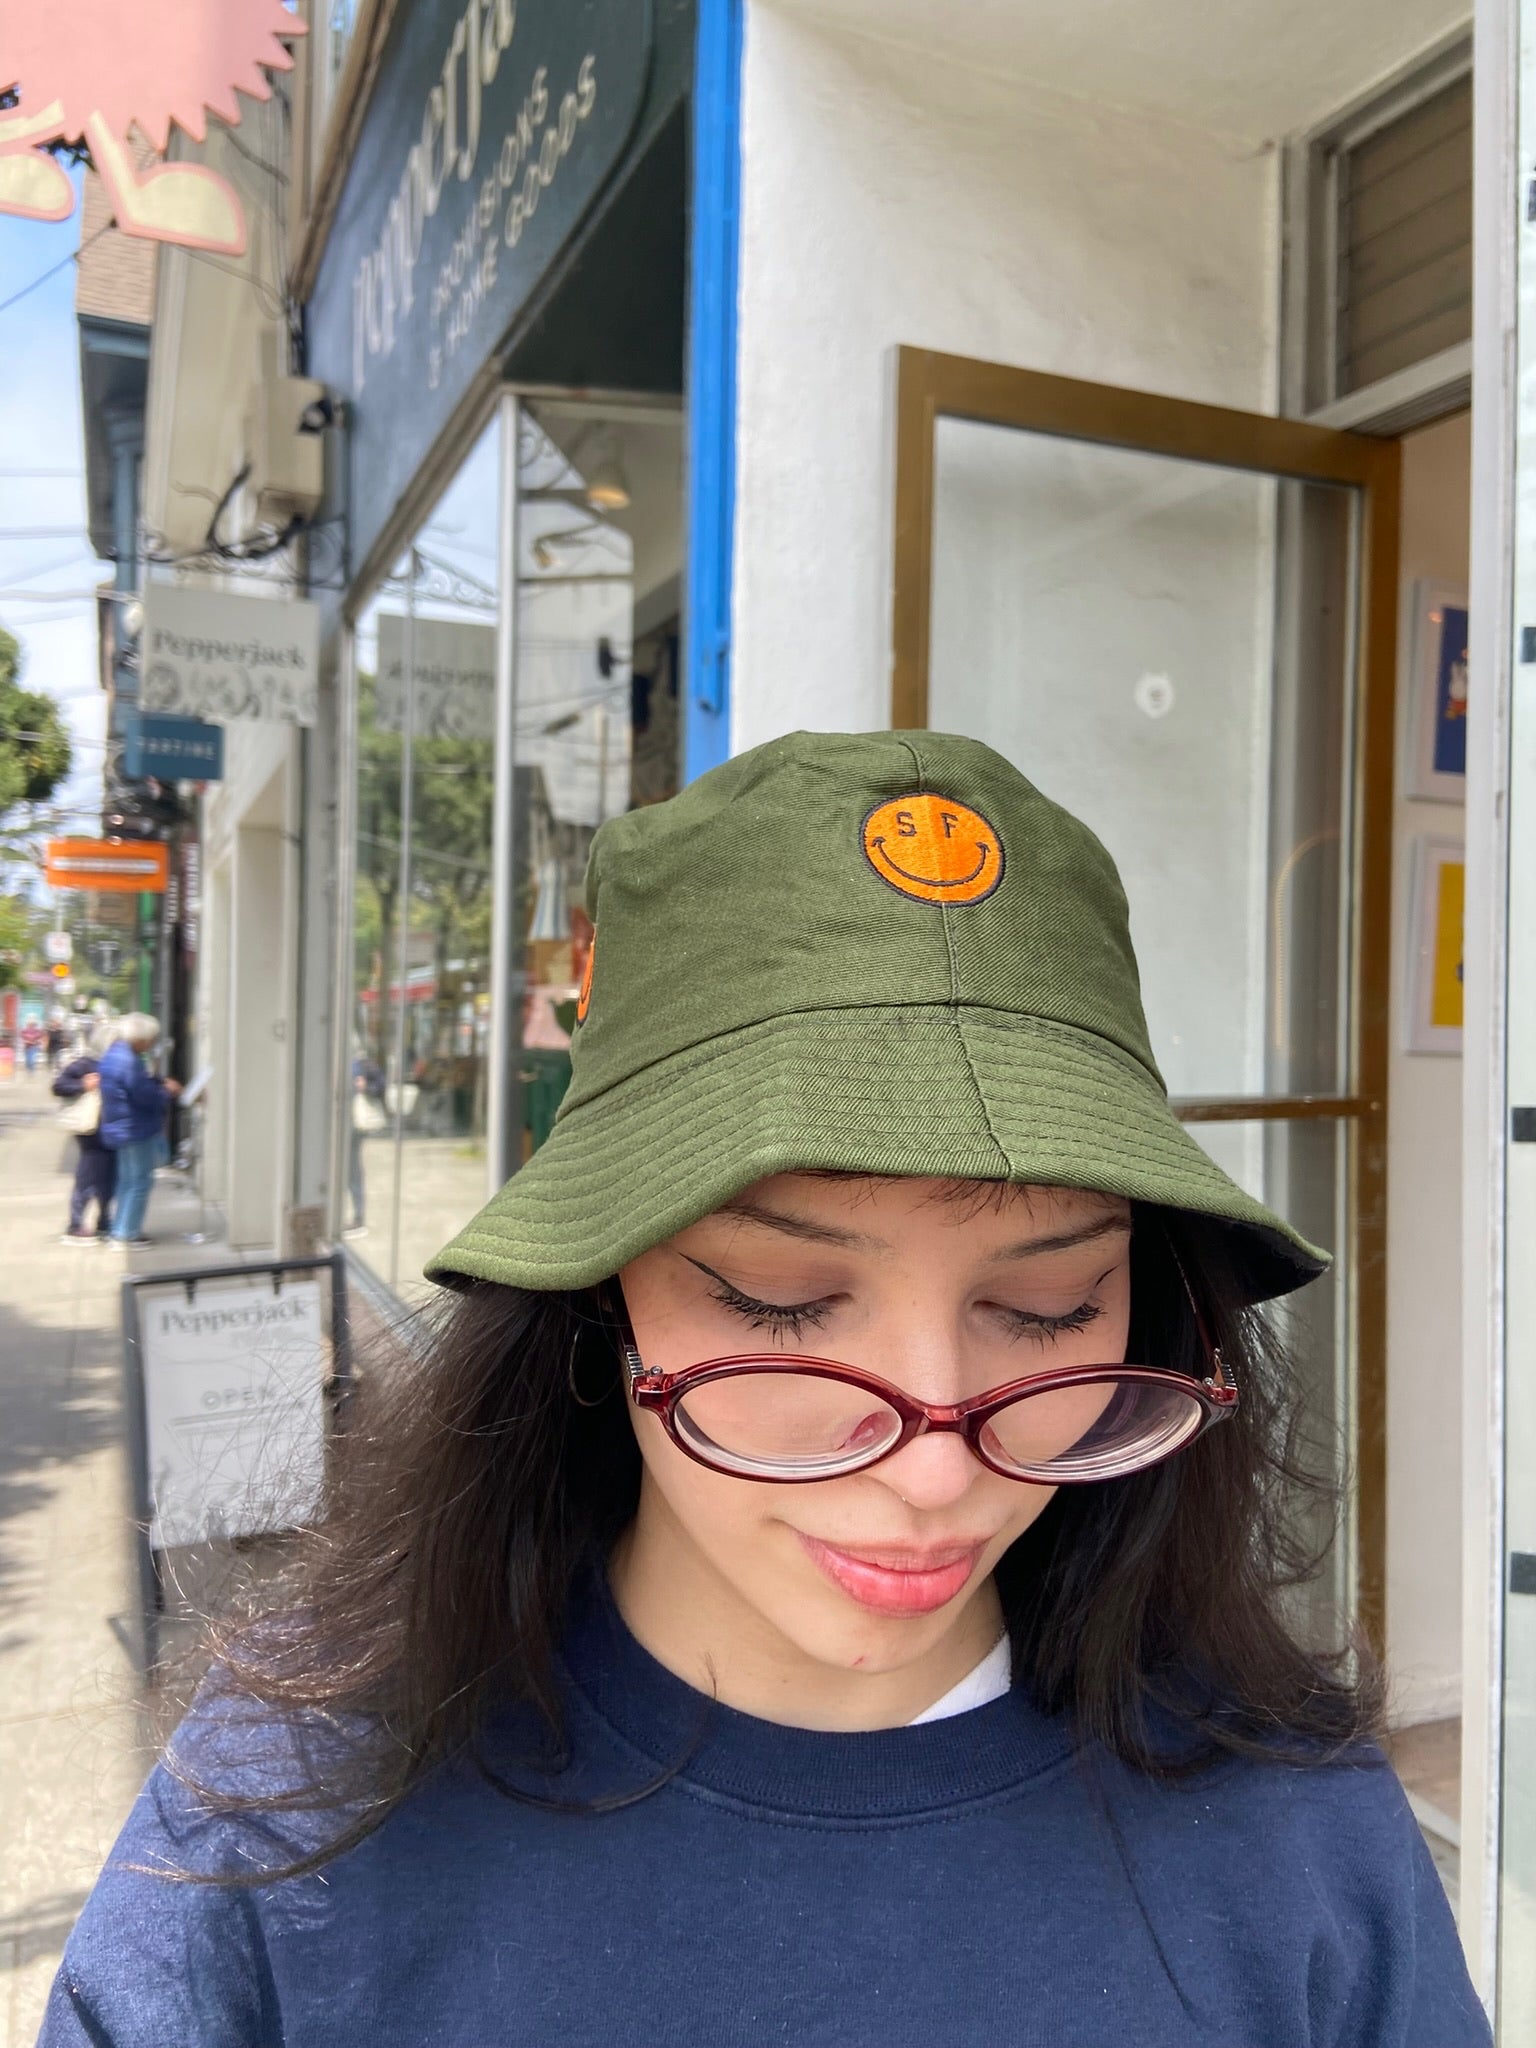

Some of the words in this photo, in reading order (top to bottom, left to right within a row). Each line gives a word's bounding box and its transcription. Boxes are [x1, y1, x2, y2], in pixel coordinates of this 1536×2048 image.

[505, 54, 596, 248] GOODS
[152, 627, 306, 671] Pepperjack
[161, 1298, 306, 1335] Pepperjack
[201, 1386, 275, 1410] OPEN
